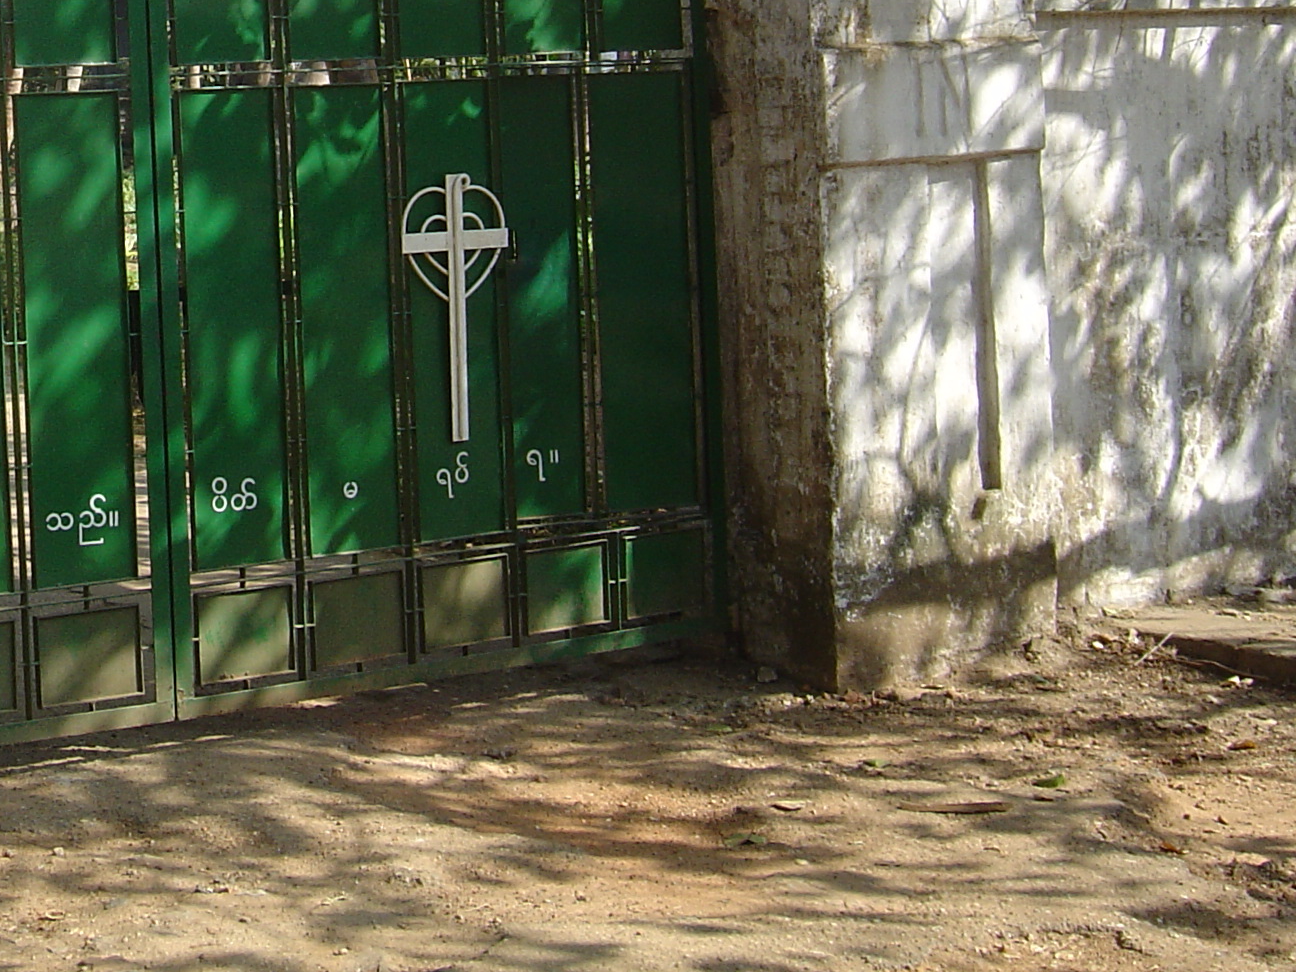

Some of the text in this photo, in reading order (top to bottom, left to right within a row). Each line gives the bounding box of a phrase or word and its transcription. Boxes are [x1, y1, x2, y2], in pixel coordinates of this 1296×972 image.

[210, 476, 258, 514] ပိတ်
[342, 479, 359, 500] မ
[435, 450, 470, 500] ရပ်
